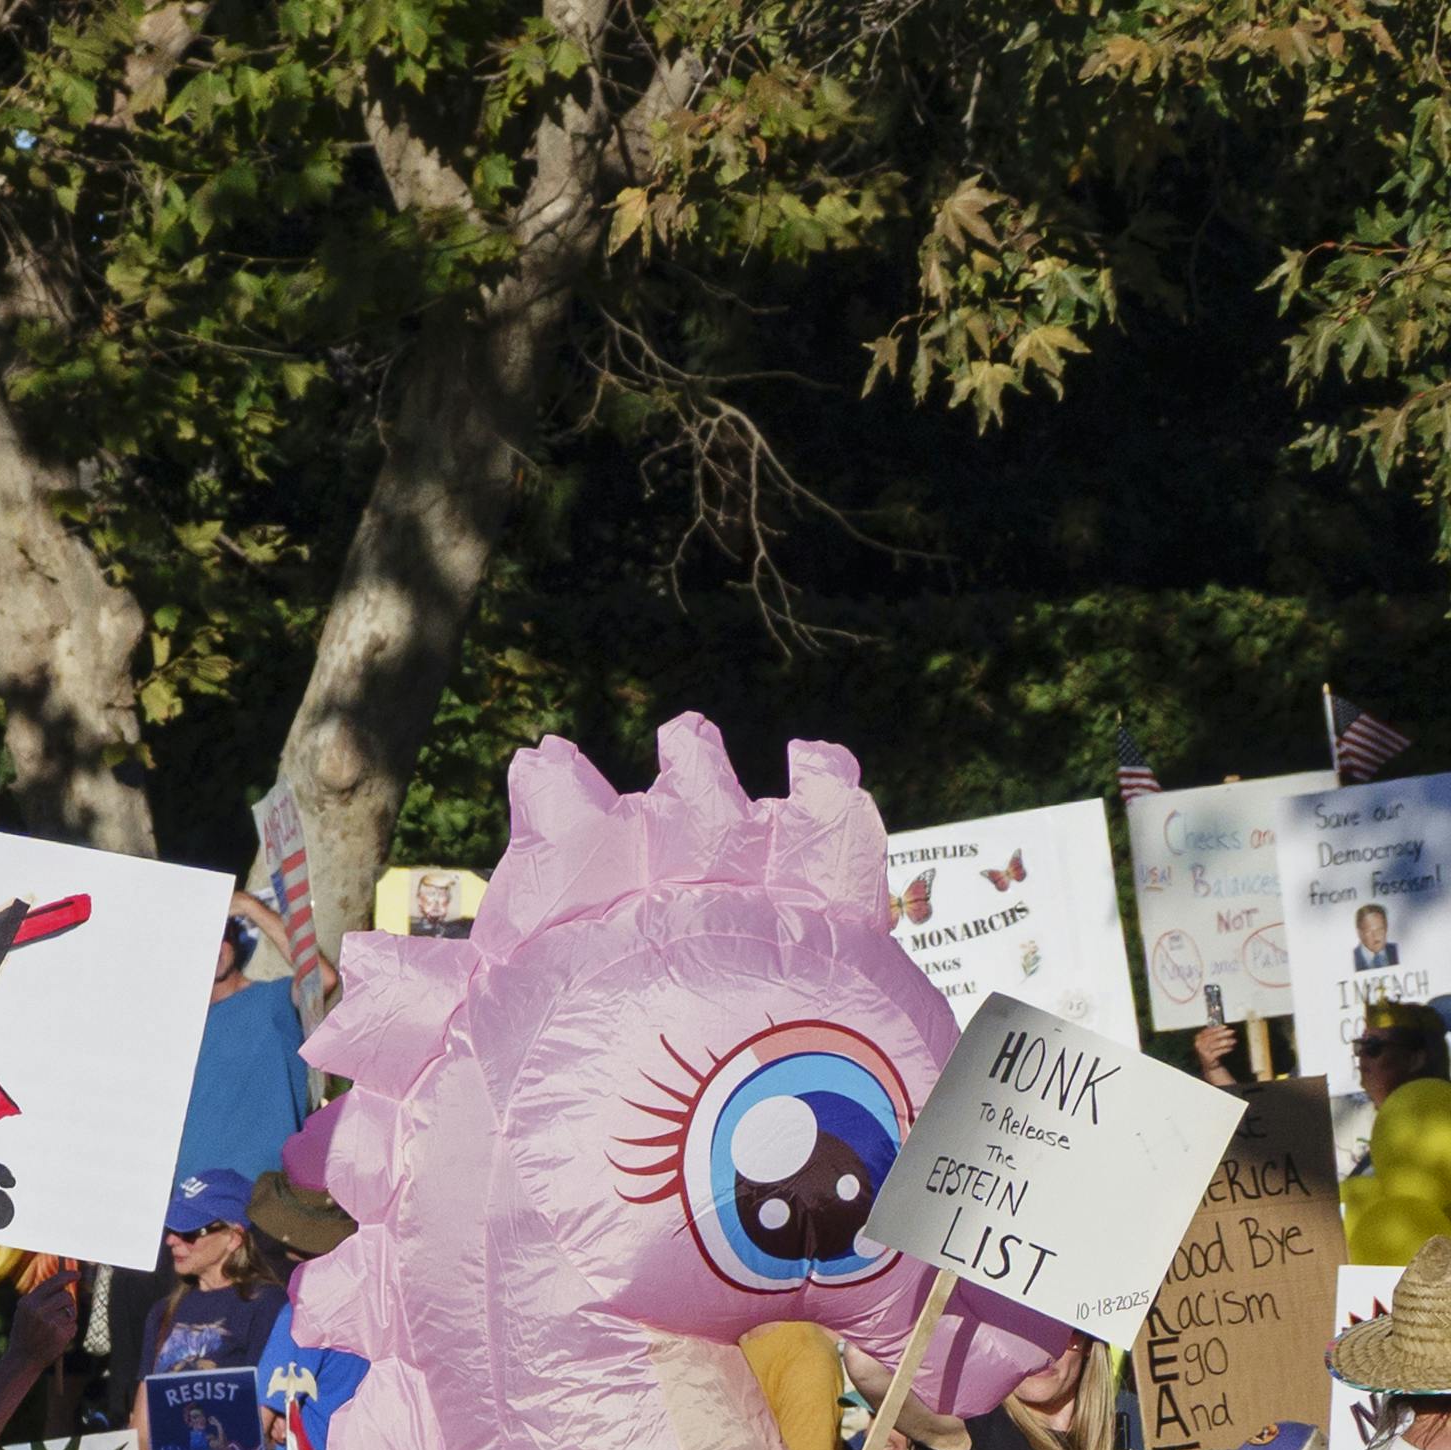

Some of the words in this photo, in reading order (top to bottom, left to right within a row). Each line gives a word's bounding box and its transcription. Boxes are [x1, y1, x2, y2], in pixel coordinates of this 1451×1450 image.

[1315, 803, 1359, 829] Save
[1373, 802, 1404, 821] our
[1251, 828, 1276, 848] an
[1319, 838, 1424, 868] Democracy
[1309, 882, 1357, 905] from
[1371, 863, 1442, 898] Fascism!
[911, 900, 1029, 952] MONARCHS
[921, 957, 961, 975] INGS
[941, 980, 976, 998] ICA!
[988, 1031, 1122, 1126] HONK
[999, 1106, 1072, 1150] Release
[987, 1144, 1017, 1170] The
[926, 1156, 1029, 1217] EPSTEIN
[1203, 1153, 1311, 1208] ERICA
[940, 1206, 1058, 1295] LIST
[1239, 1217, 1314, 1269] Bye
[1075, 1290, 1150, 1320] 10-18-2025
[165, 1382, 239, 1407] RESIST
[1156, 1383, 1234, 1439] And
